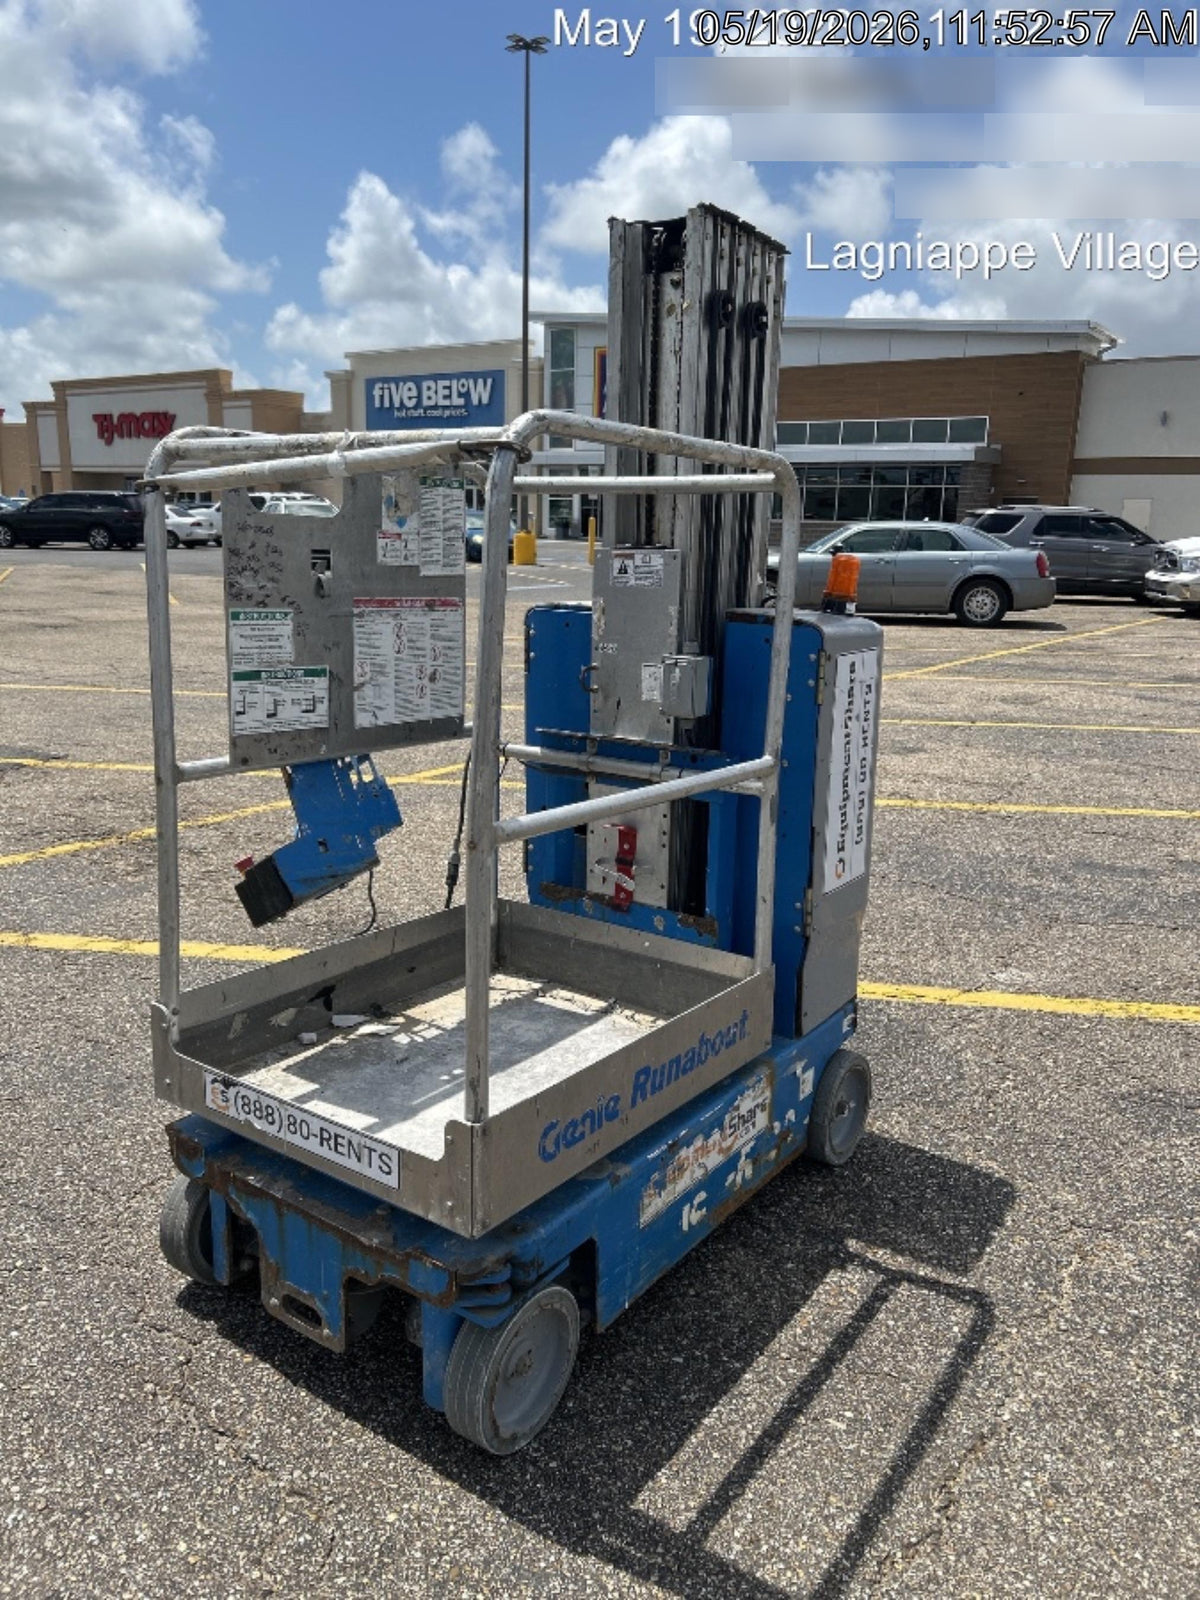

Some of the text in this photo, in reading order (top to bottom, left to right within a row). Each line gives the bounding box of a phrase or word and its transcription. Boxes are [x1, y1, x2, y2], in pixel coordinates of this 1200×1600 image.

[422, 378, 493, 406] BELOW
[538, 1009, 748, 1163] Genie Runabout
[234, 1090, 283, 1133] (888)
[287, 1114, 392, 1176] 80-RENTS
